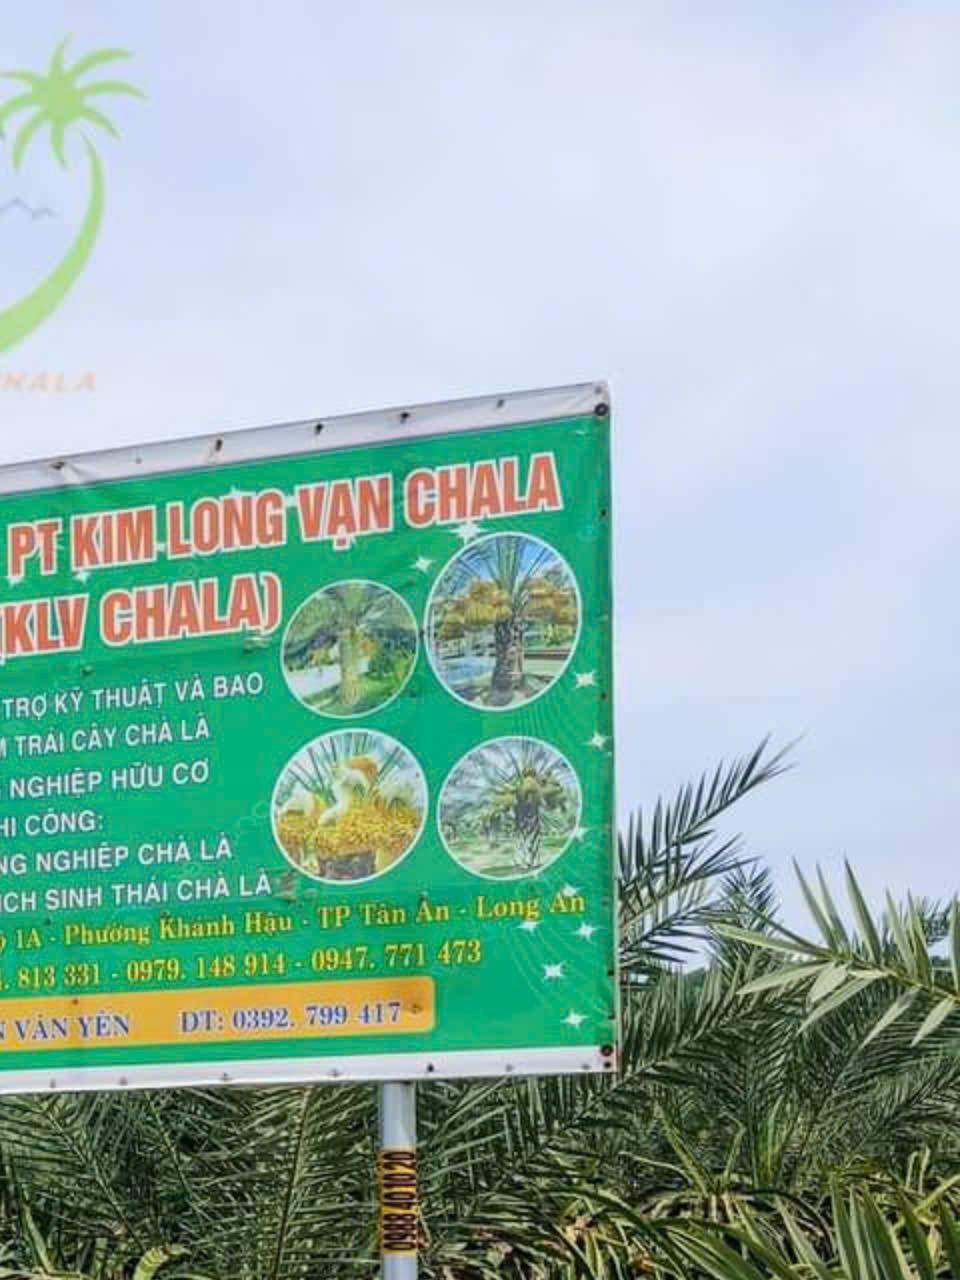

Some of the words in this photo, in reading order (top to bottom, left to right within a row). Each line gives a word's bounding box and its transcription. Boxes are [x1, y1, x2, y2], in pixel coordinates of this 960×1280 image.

[7, 518, 62, 580] PT
[71, 506, 157, 571] KIM
[166, 490, 287, 560] LONG
[295, 472, 394, 550] VẠN
[404, 451, 563, 527] CHALA
[100, 572, 281, 646] CHALA)
[91, 679, 167, 710] THUẬT
[175, 673, 205, 701] VÀ
[213, 672, 263, 698] BAO
[9, 768, 102, 799] NGHIỆP
[111, 761, 163, 790] HỮU
[172, 758, 209, 785] CƠ
[25, 808, 103, 836] CÔNG:
[35, 842, 128, 872] NGHIỆP
[45, 887, 103, 911] SINH
[16, 927, 42, 949] 1A
[317, 904, 352, 929] TP
[474, 895, 540, 921] Long
[550, 893, 585, 914] An
[18, 965, 56, 988] 813
[63, 961, 100, 986] 331
[197, 953, 235, 979] 148
[244, 952, 286, 976] 914
[385, 942, 426, 967] 771
[438, 938, 481, 965] 473
[306, 1004, 348, 1026] 799
[359, 1001, 401, 1023] 417
